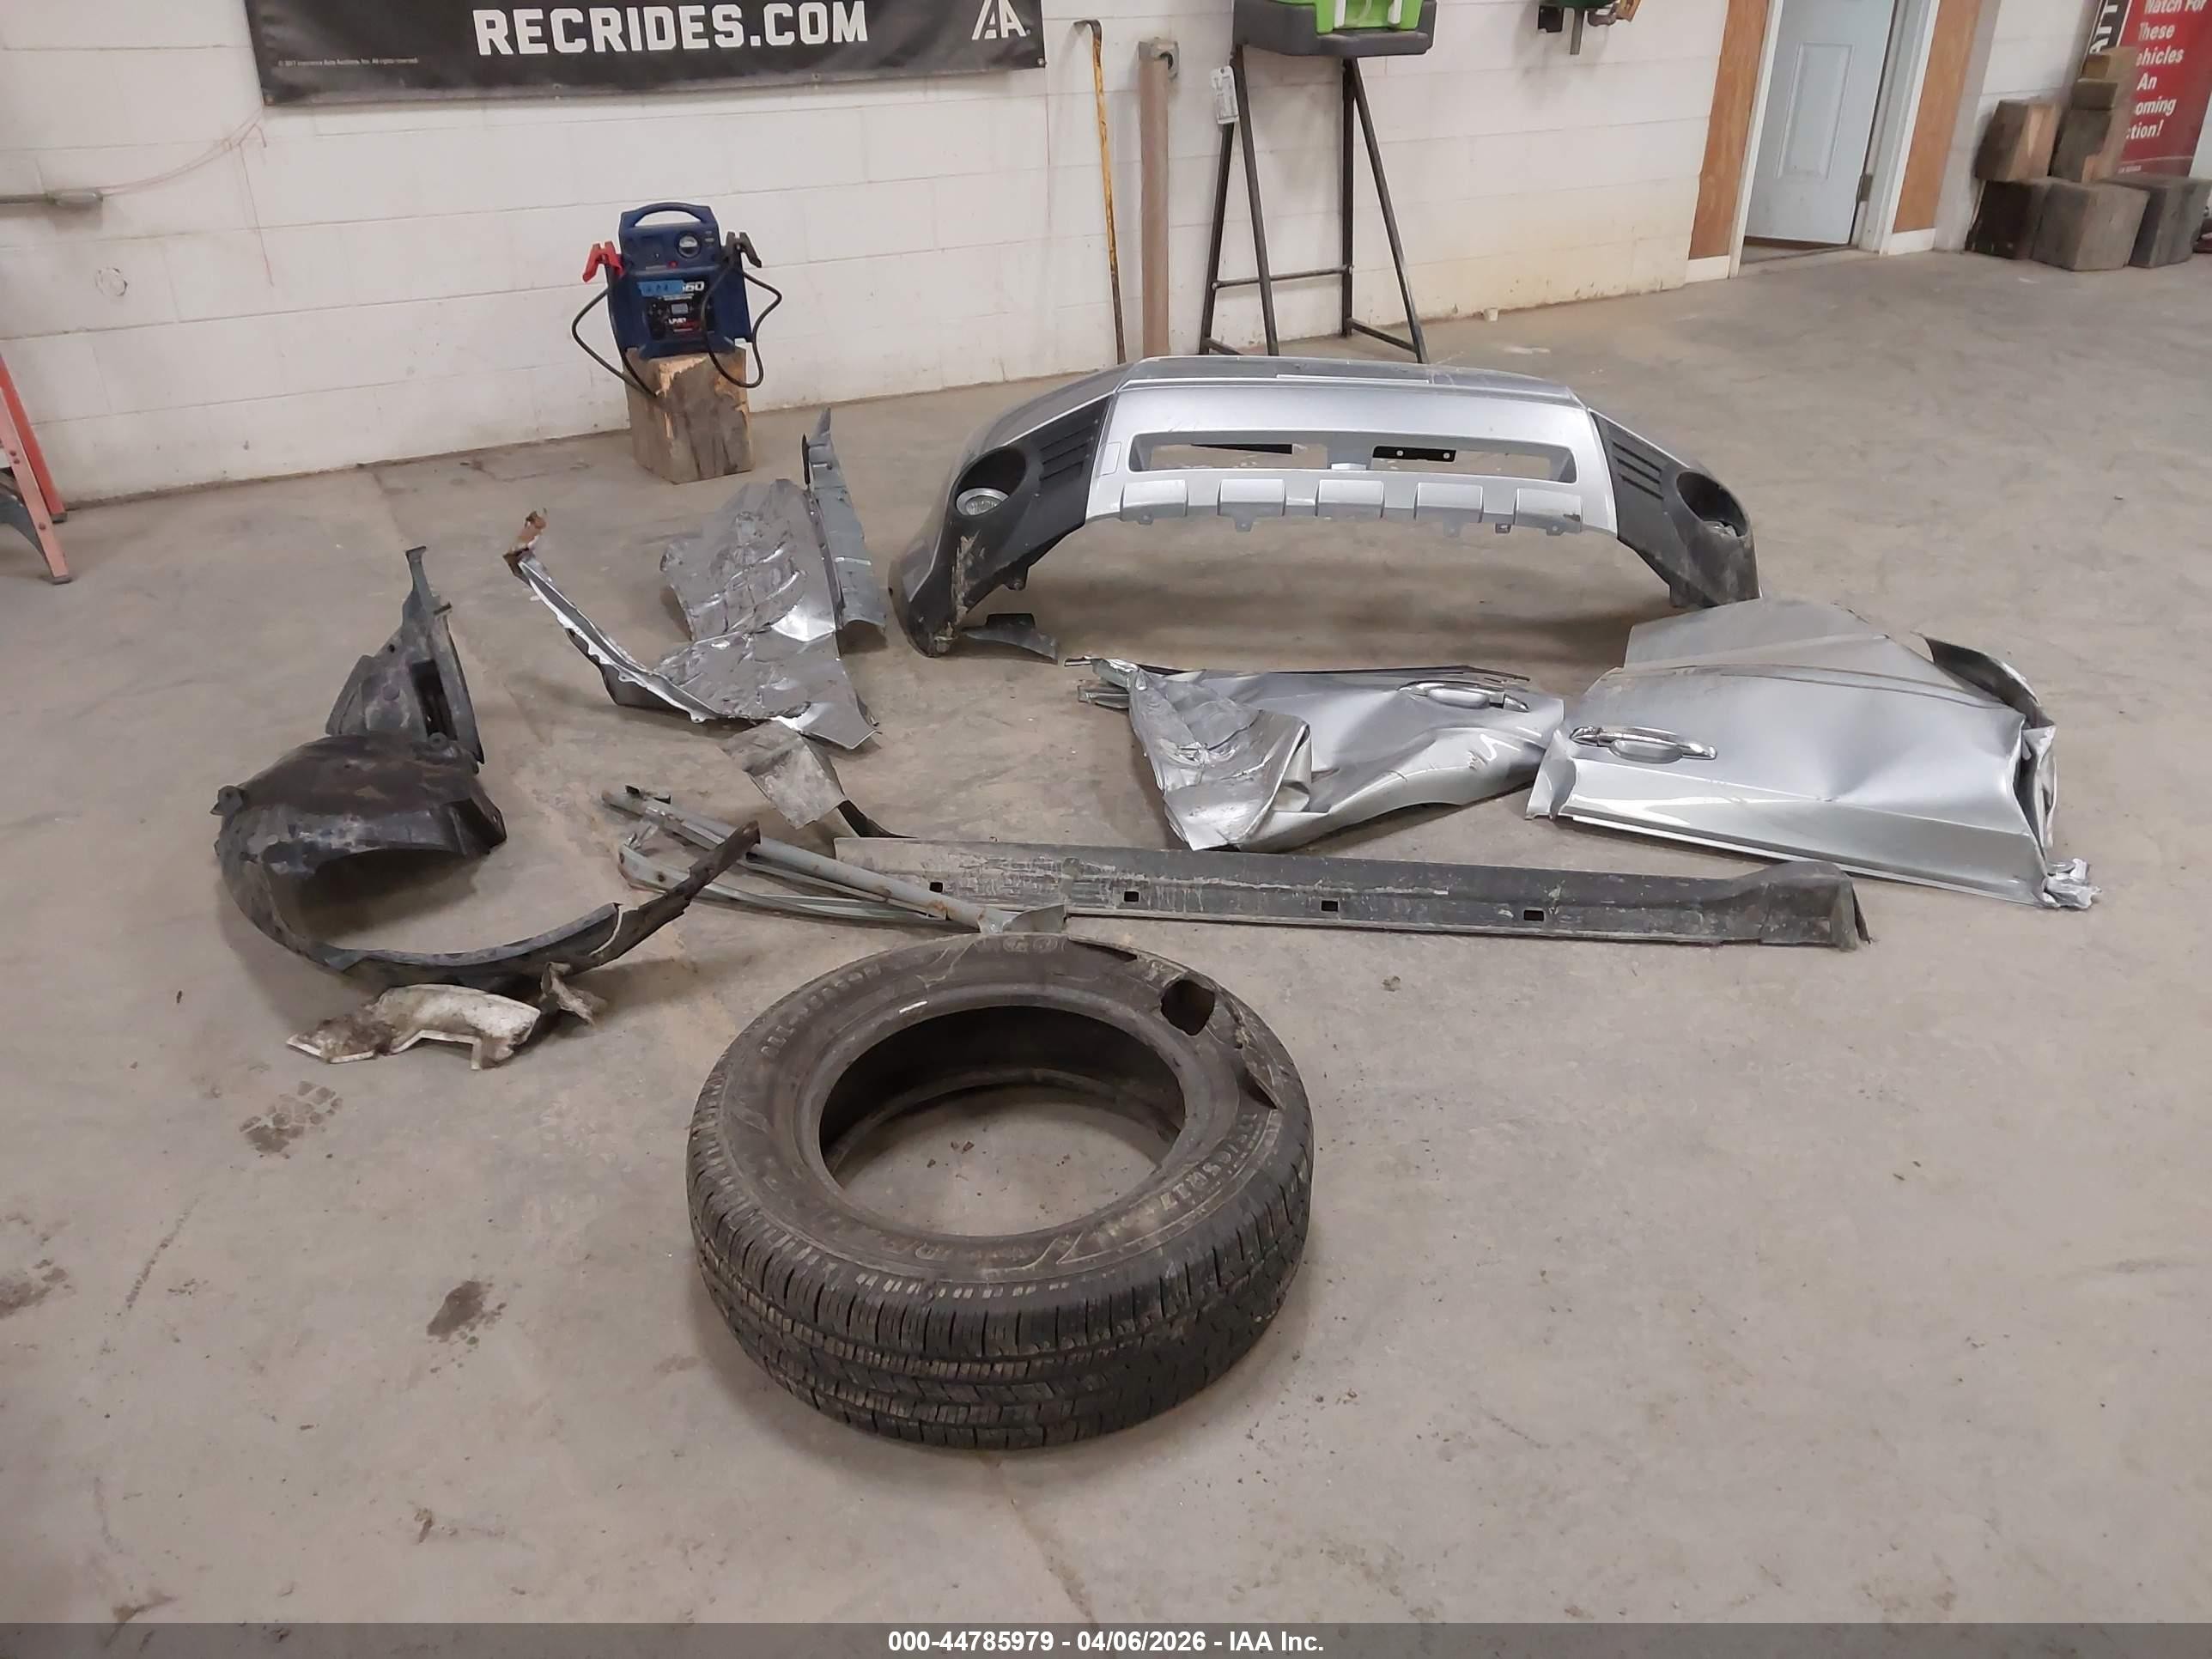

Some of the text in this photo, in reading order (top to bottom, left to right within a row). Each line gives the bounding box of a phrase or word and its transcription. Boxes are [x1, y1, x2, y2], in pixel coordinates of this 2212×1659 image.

[472, 0, 868, 56] RECRIDES.COM
[2138, 21, 2175, 41] These
[2136, 45, 2185, 67] ehicles
[2136, 72, 2158, 91] An
